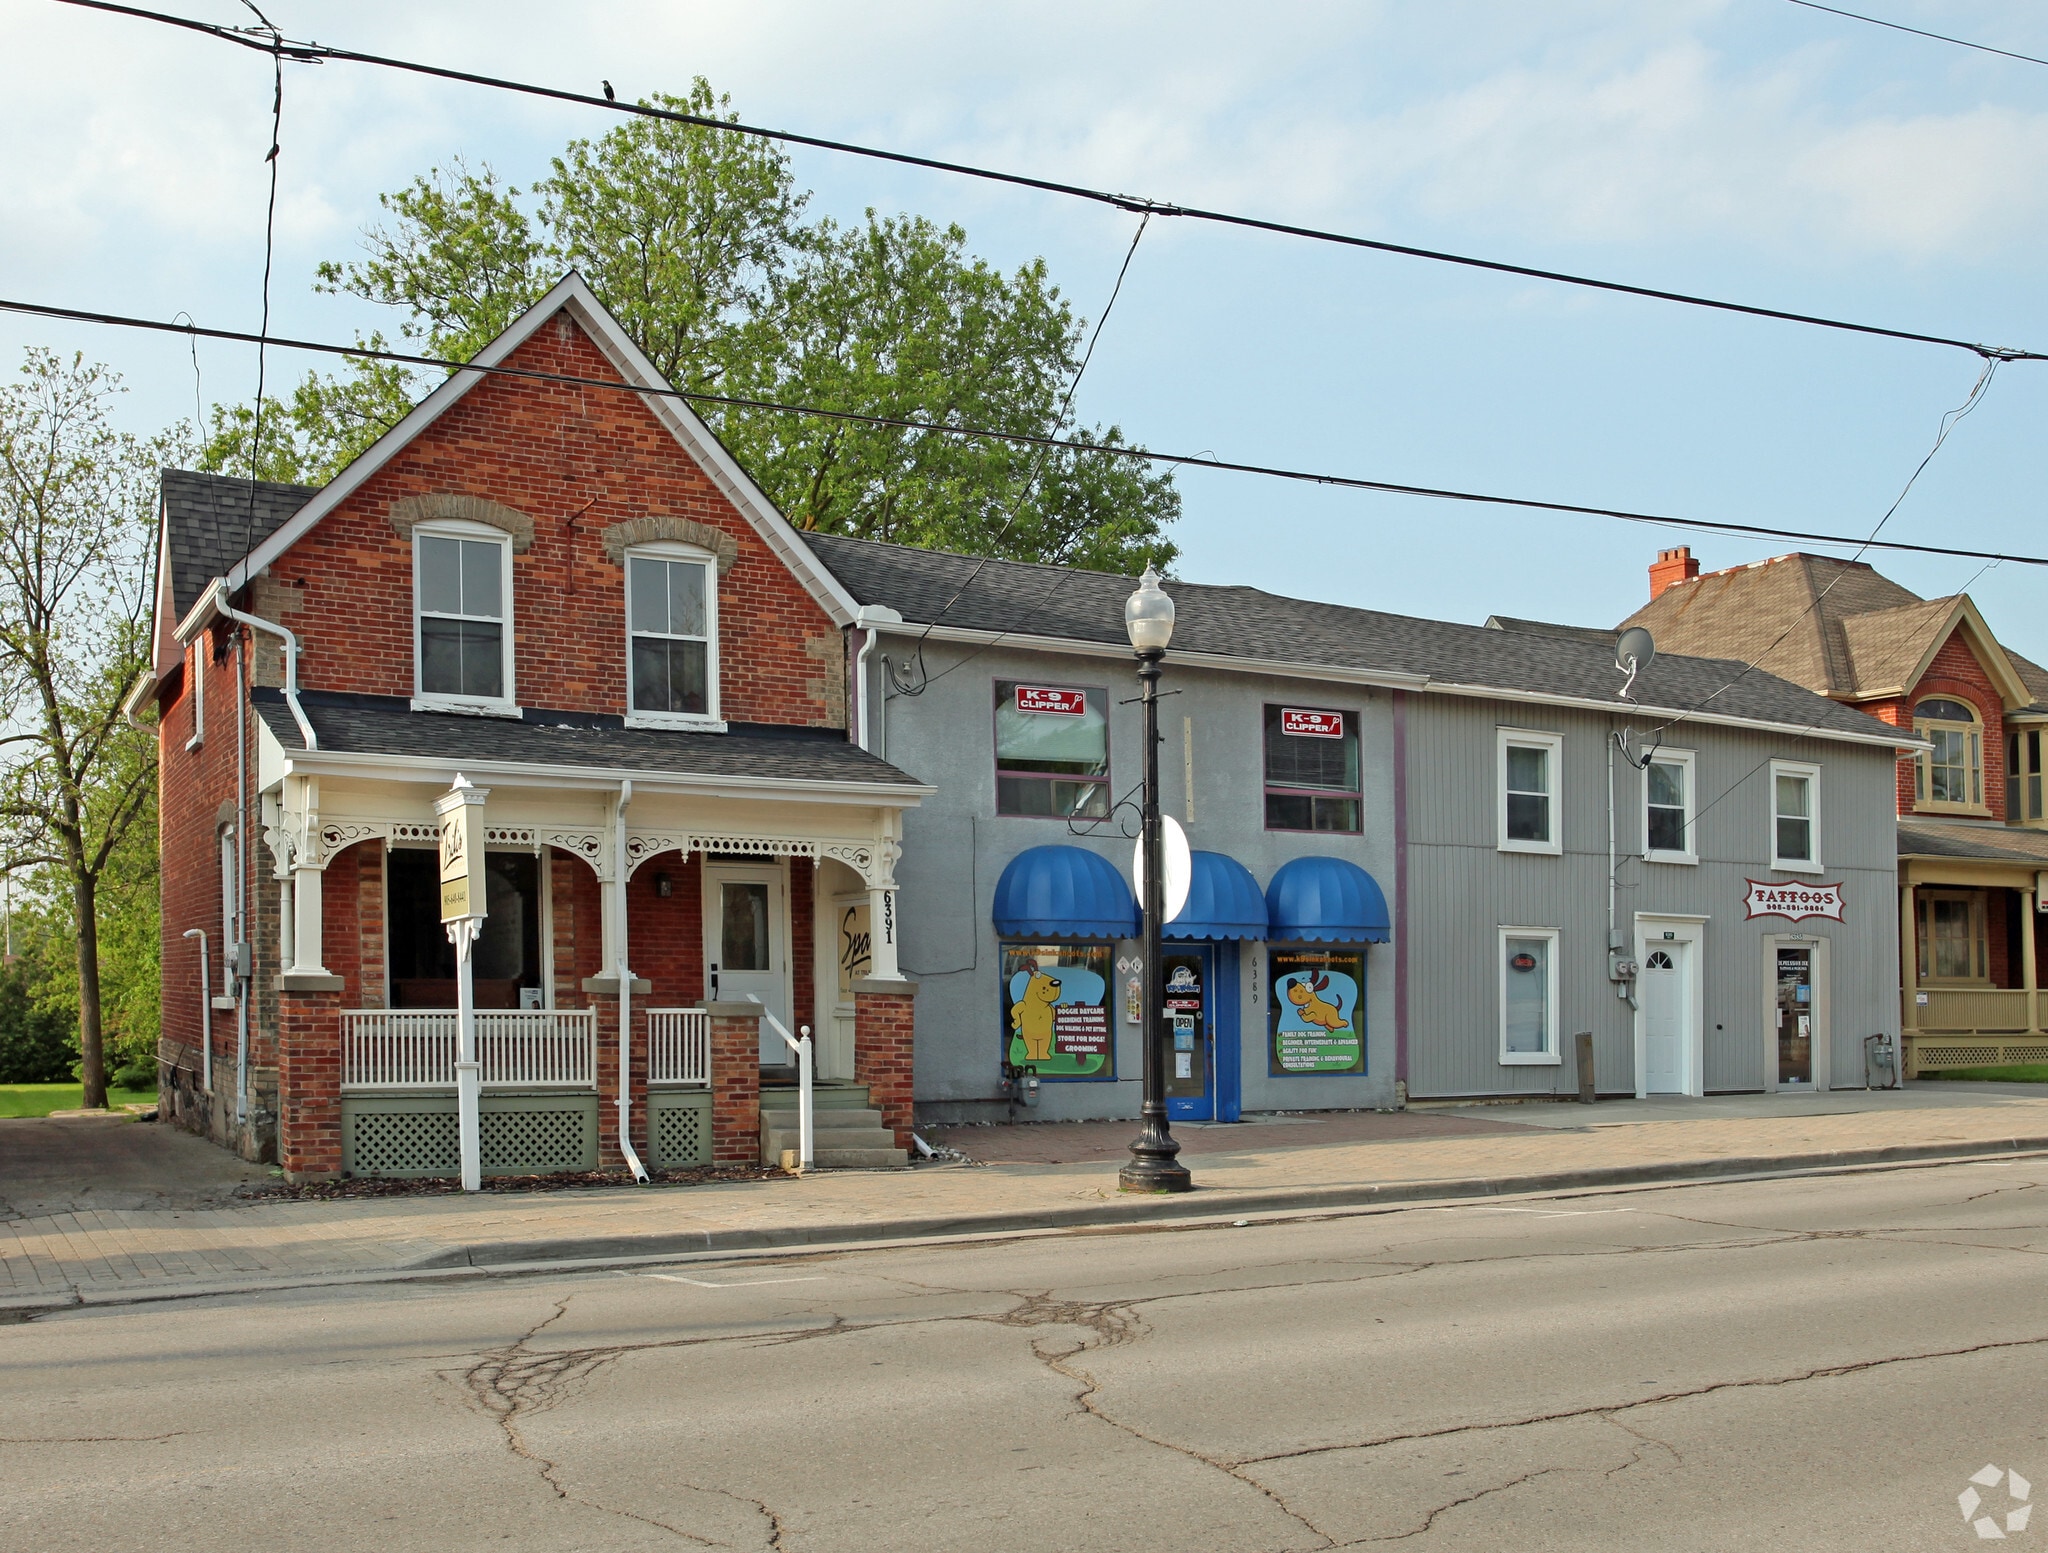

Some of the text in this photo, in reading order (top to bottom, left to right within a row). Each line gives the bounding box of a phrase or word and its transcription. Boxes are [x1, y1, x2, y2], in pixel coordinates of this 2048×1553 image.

[1026, 690, 1062, 701] K-9
[1020, 700, 1070, 711] CLIPPER
[1291, 713, 1322, 723] K-9
[1286, 723, 1330, 732] CLIPPER
[1755, 889, 1835, 904] TATTOOS
[884, 890, 893, 944] 6391
[1175, 1017, 1192, 1028] OPEN
